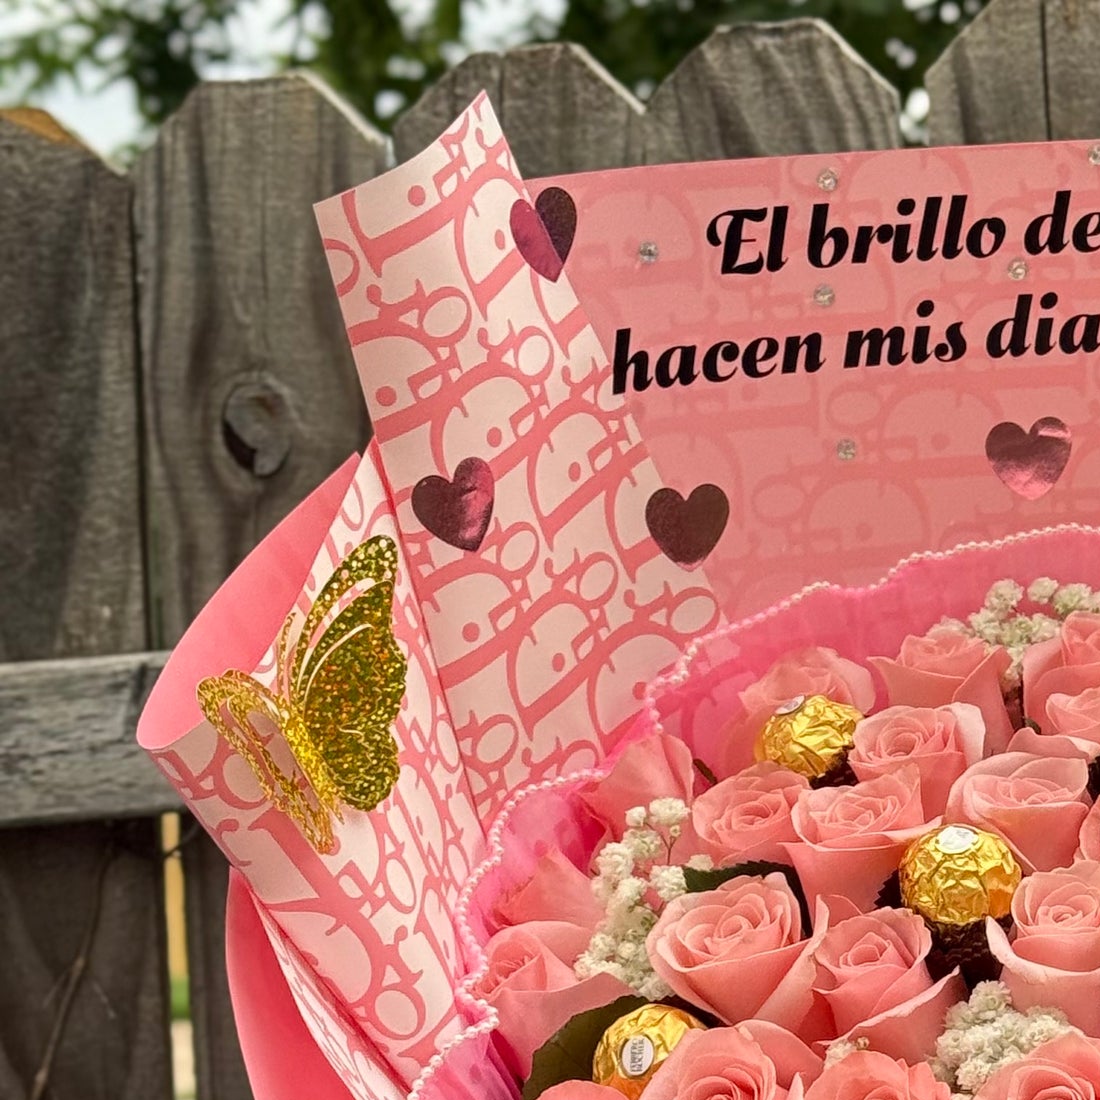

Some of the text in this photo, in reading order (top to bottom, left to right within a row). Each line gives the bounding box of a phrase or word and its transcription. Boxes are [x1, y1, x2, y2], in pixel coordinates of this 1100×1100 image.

[706, 205, 789, 275] El
[807, 194, 1006, 268] brillo
[612, 327, 826, 395] hacen
[843, 300, 967, 369] mis
